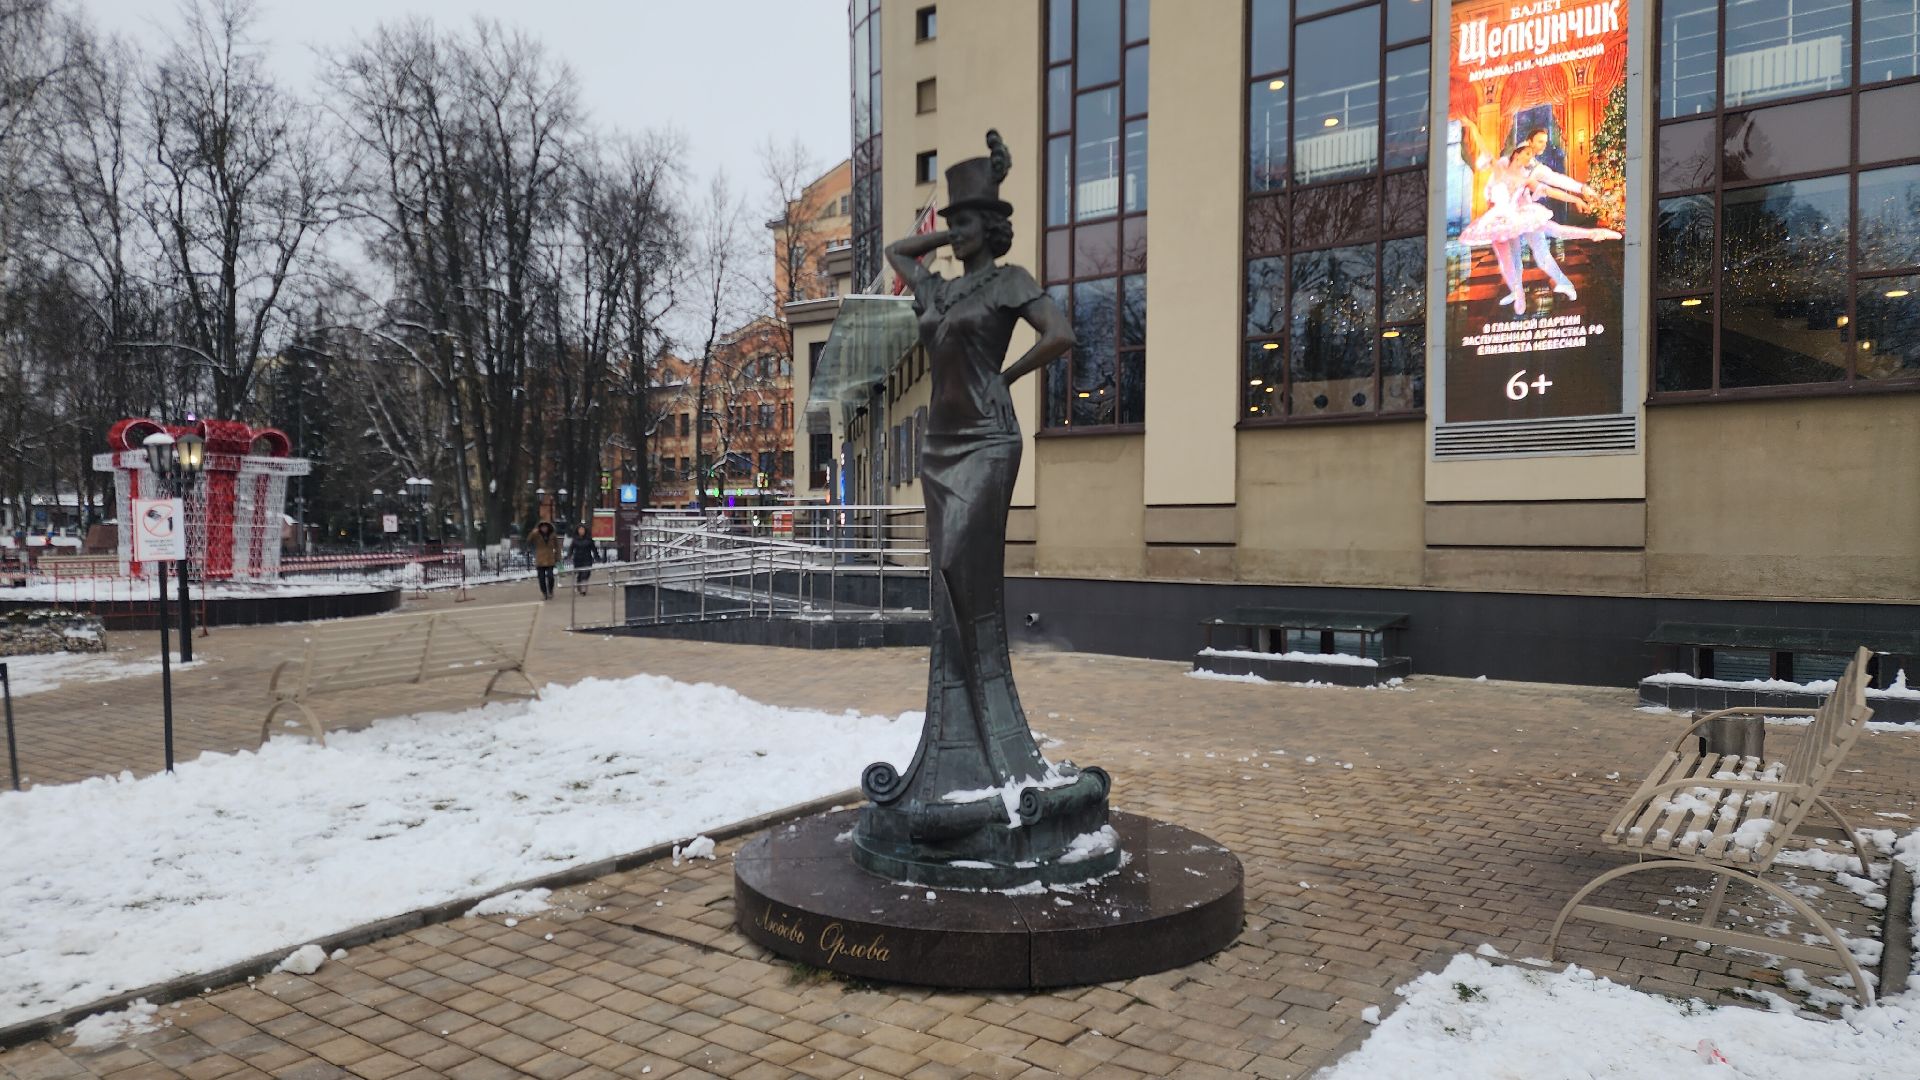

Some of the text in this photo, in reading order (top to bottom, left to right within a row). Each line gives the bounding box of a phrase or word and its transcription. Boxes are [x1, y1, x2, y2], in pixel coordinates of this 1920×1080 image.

[1459, 1, 1620, 66] Щелкунчик
[1535, 42, 1604, 67] ЧАЙКОВСКИЙ
[1462, 330, 1532, 347] ЗАСЛУЖЕННАЯ
[1533, 325, 1587, 340] АРТИСТКА
[1482, 314, 1581, 334] В ГЛАВНОЙ ПАРТИИ
[1506, 369, 1553, 400] 6+
[755, 903, 891, 965] Любовь Орлова
